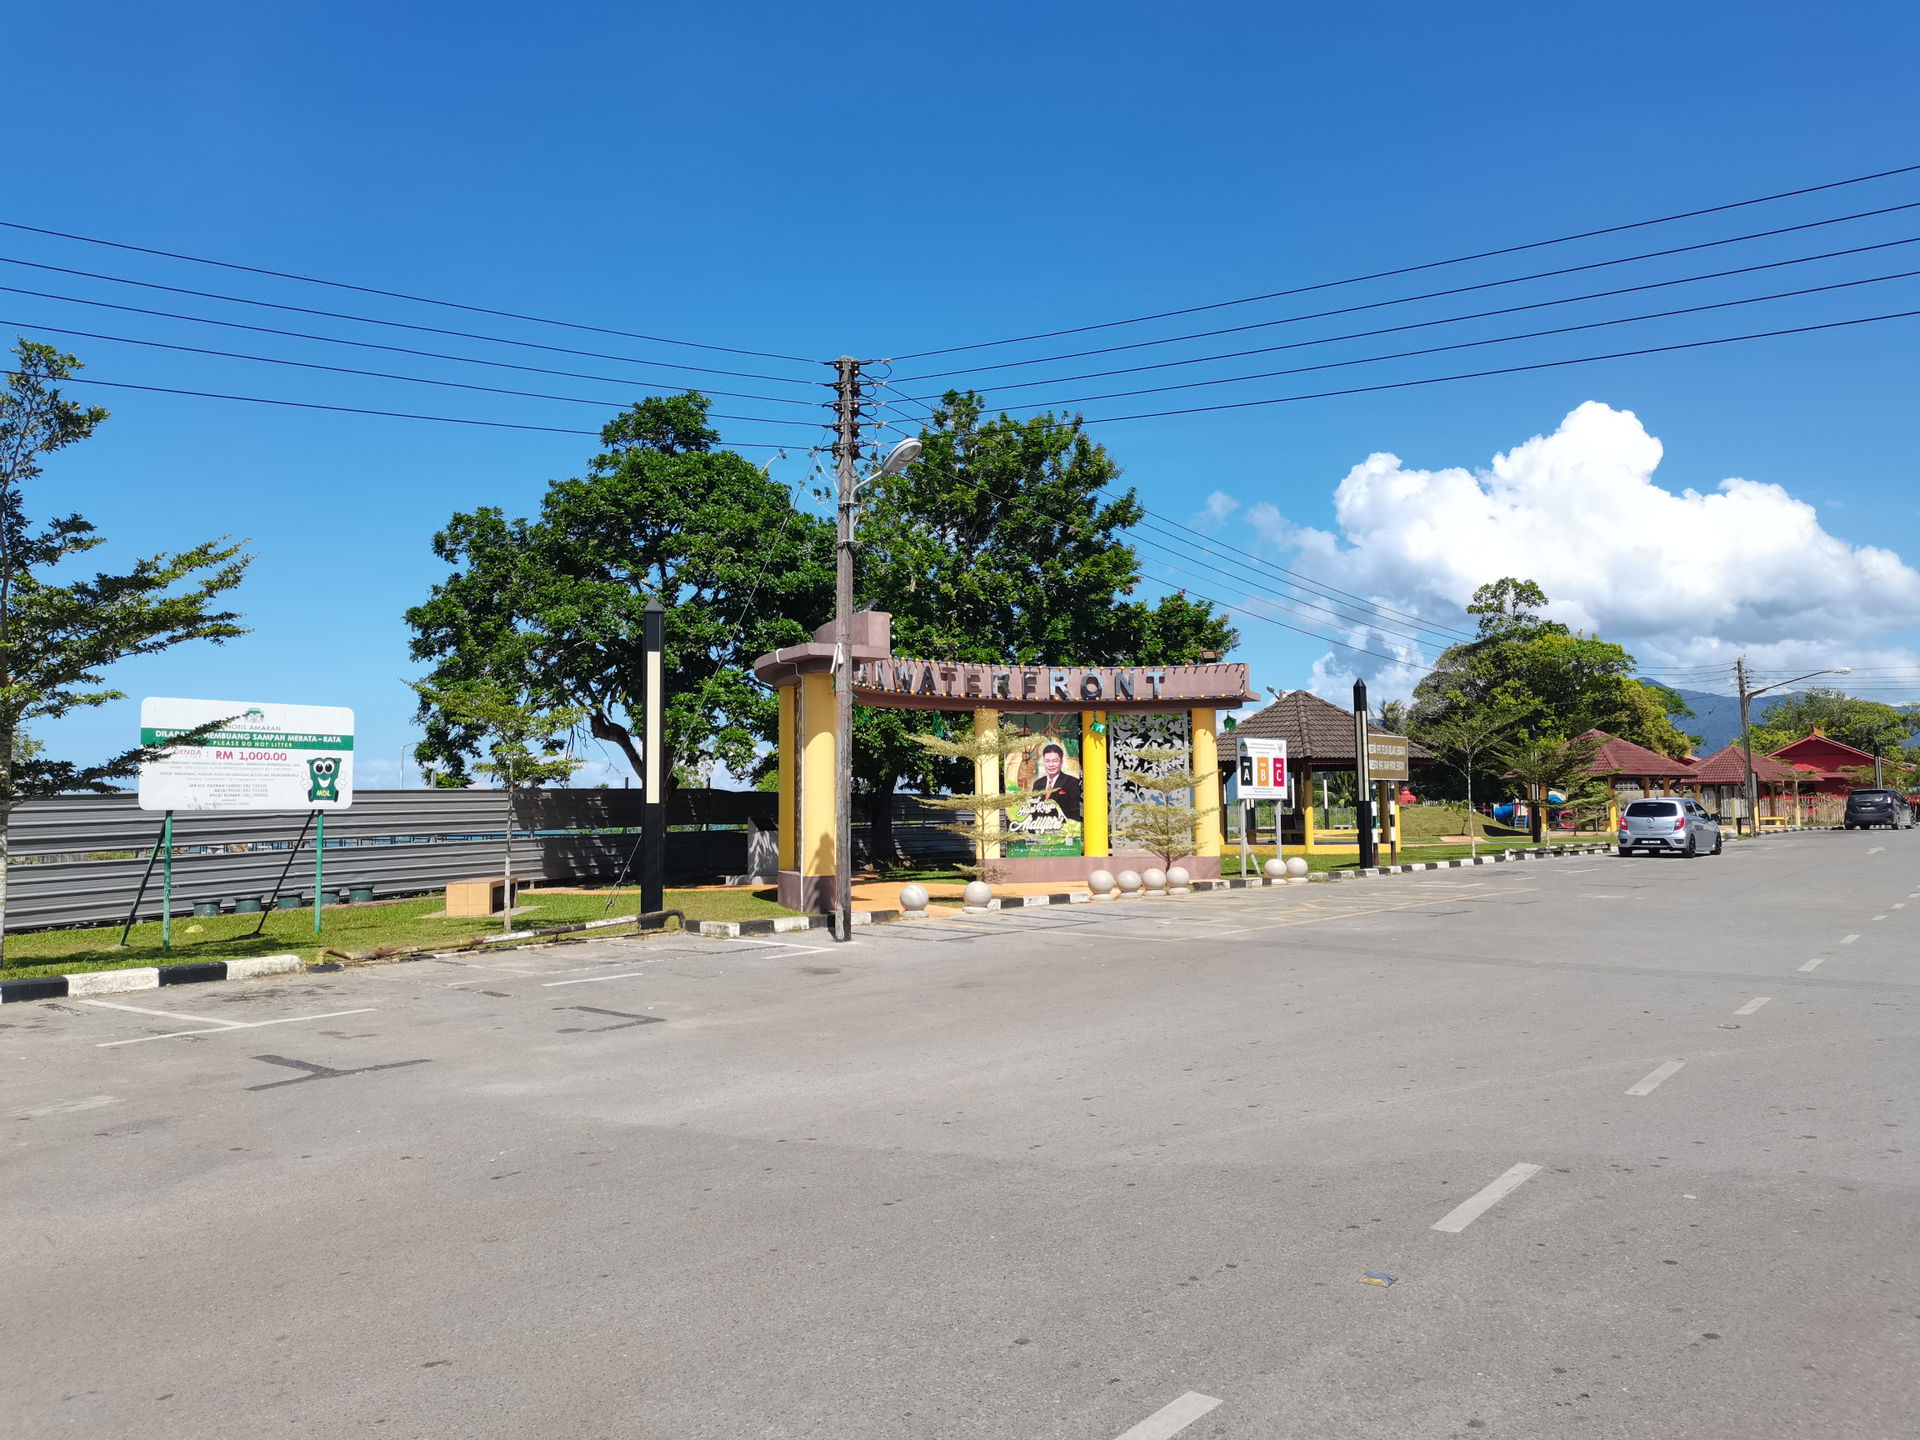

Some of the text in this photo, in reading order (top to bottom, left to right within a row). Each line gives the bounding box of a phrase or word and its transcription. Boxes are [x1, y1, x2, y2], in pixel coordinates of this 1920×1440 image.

[893, 660, 1166, 699] WATERFRONT
[202, 731, 250, 741] MEMBUANG
[252, 733, 286, 742] SAMPAH
[215, 750, 234, 760] RM
[239, 751, 287, 761] 1,000.00
[1244, 768, 1282, 782] A B C
[1016, 800, 1057, 816] Hari Raya
